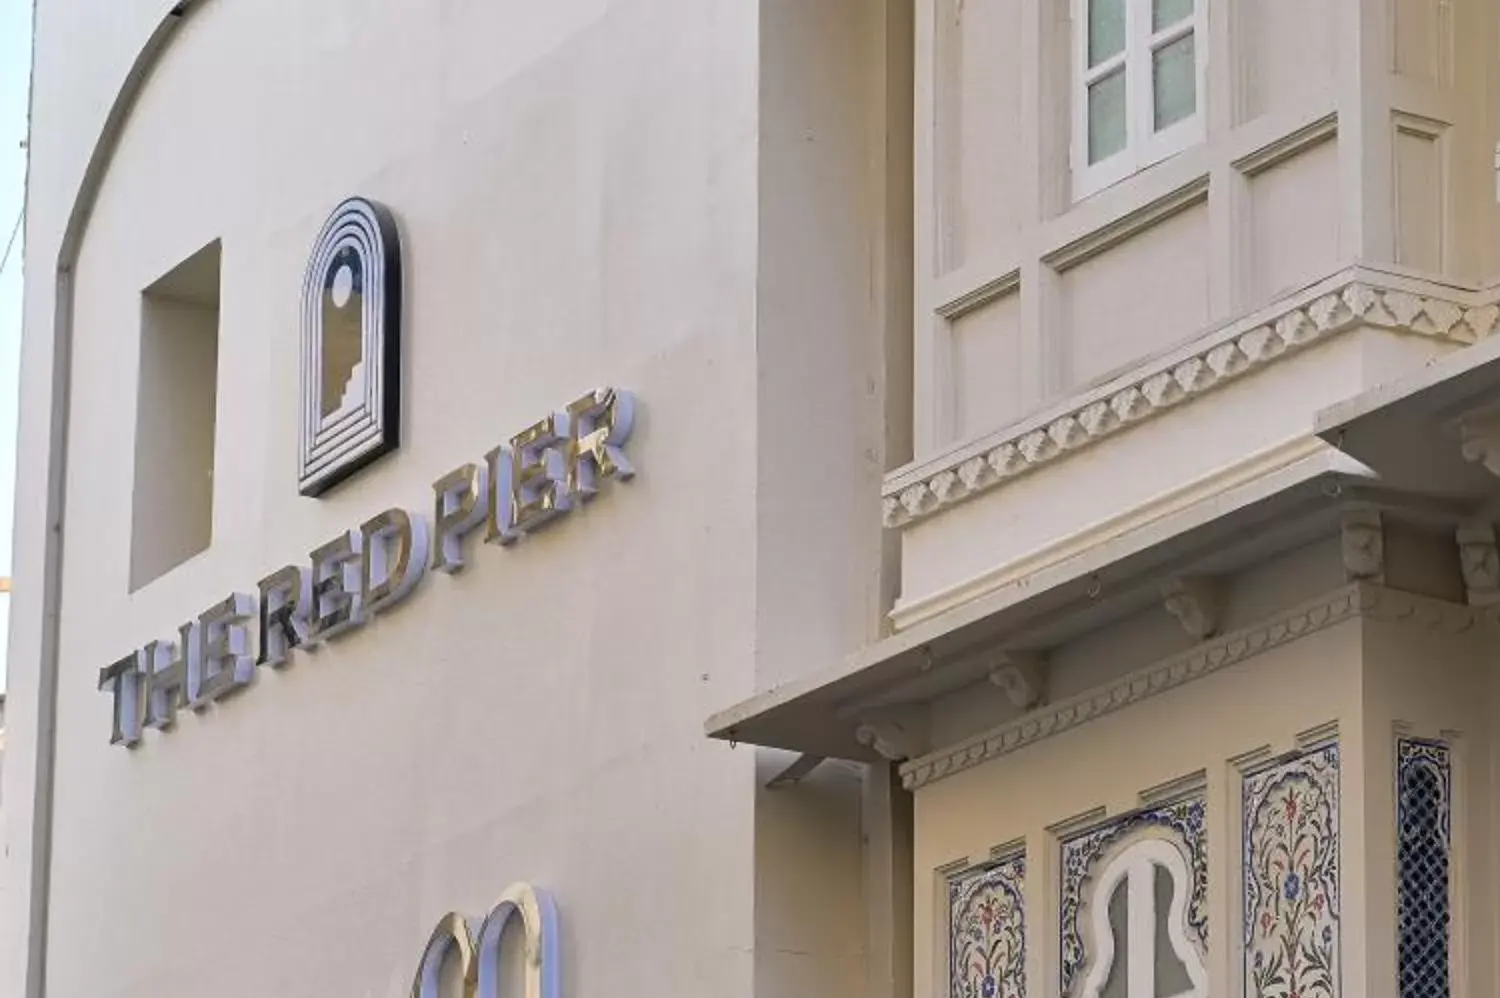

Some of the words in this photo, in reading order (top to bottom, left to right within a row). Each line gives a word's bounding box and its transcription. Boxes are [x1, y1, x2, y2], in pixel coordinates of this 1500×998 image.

[97, 592, 258, 748] THE
[256, 506, 429, 667] RED
[432, 386, 637, 576] PIER
